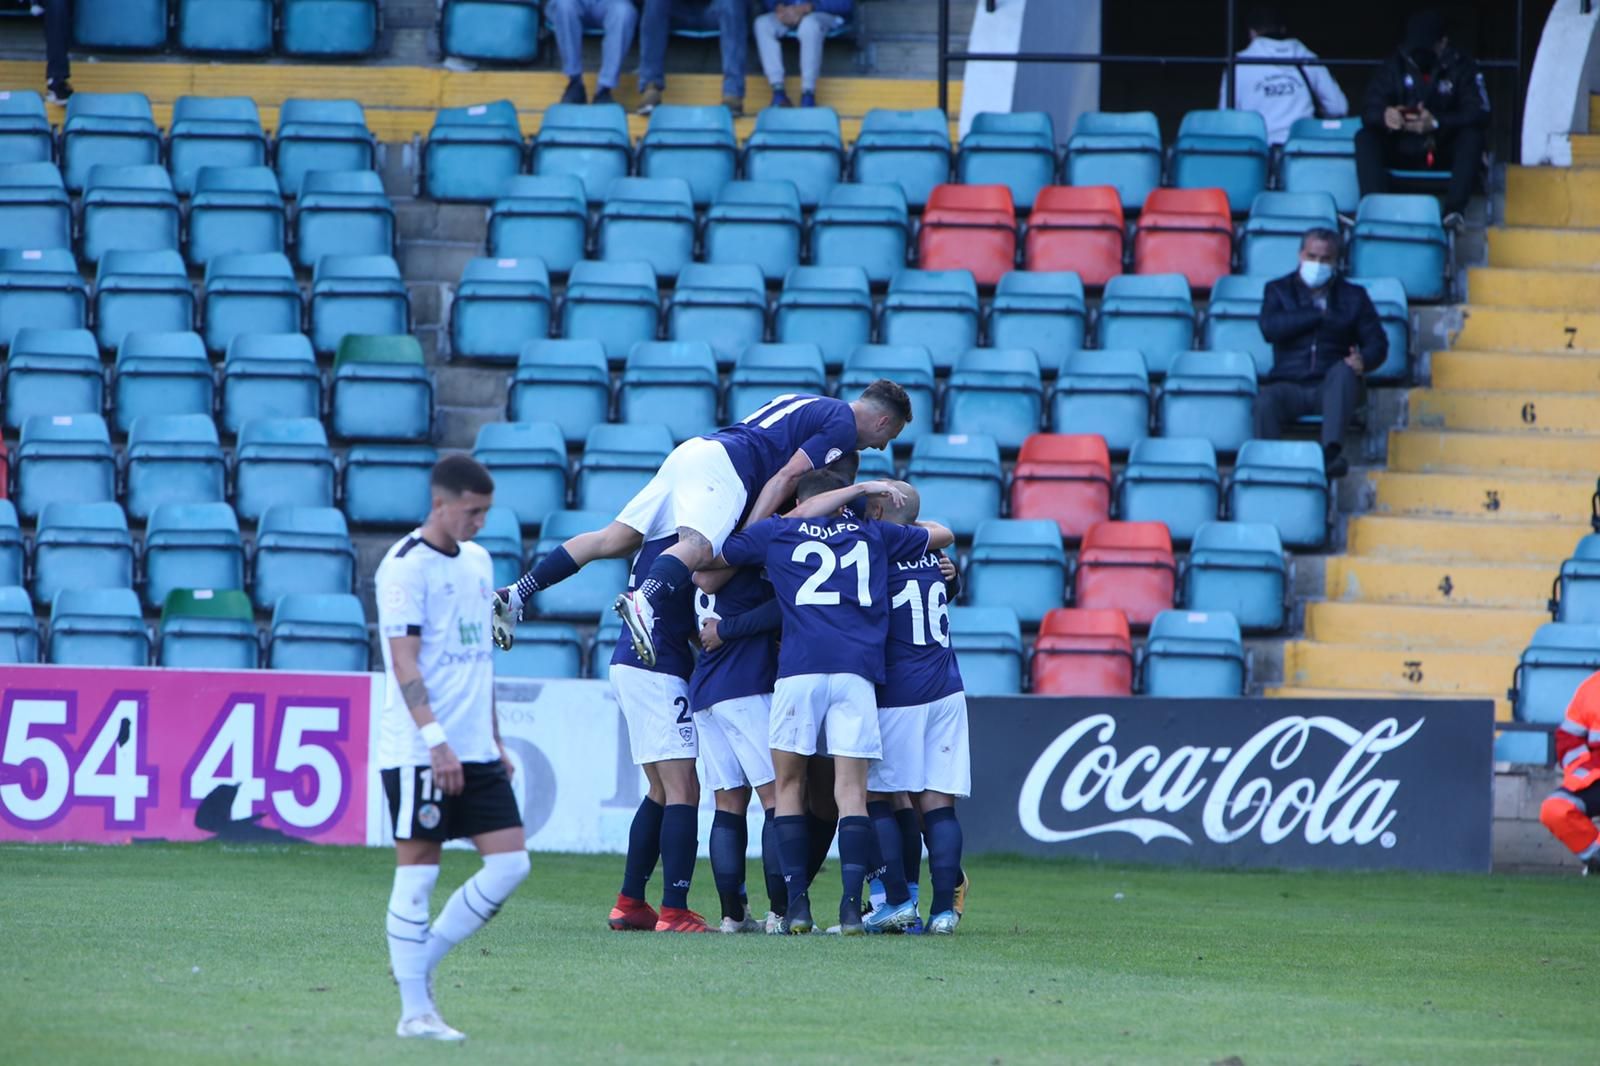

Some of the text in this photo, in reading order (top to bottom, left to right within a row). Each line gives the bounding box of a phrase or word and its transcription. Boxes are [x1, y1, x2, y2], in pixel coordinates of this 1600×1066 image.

[1563, 327, 1578, 349] 7
[741, 393, 820, 429] 11
[1521, 402, 1537, 425] 6
[798, 521, 860, 540] ADOLFO
[791, 540, 873, 607] 21
[892, 579, 950, 649] 16
[674, 696, 692, 724] 2
[0, 699, 343, 828] 54 45
[1018, 713, 1426, 846] Coca-Cola
